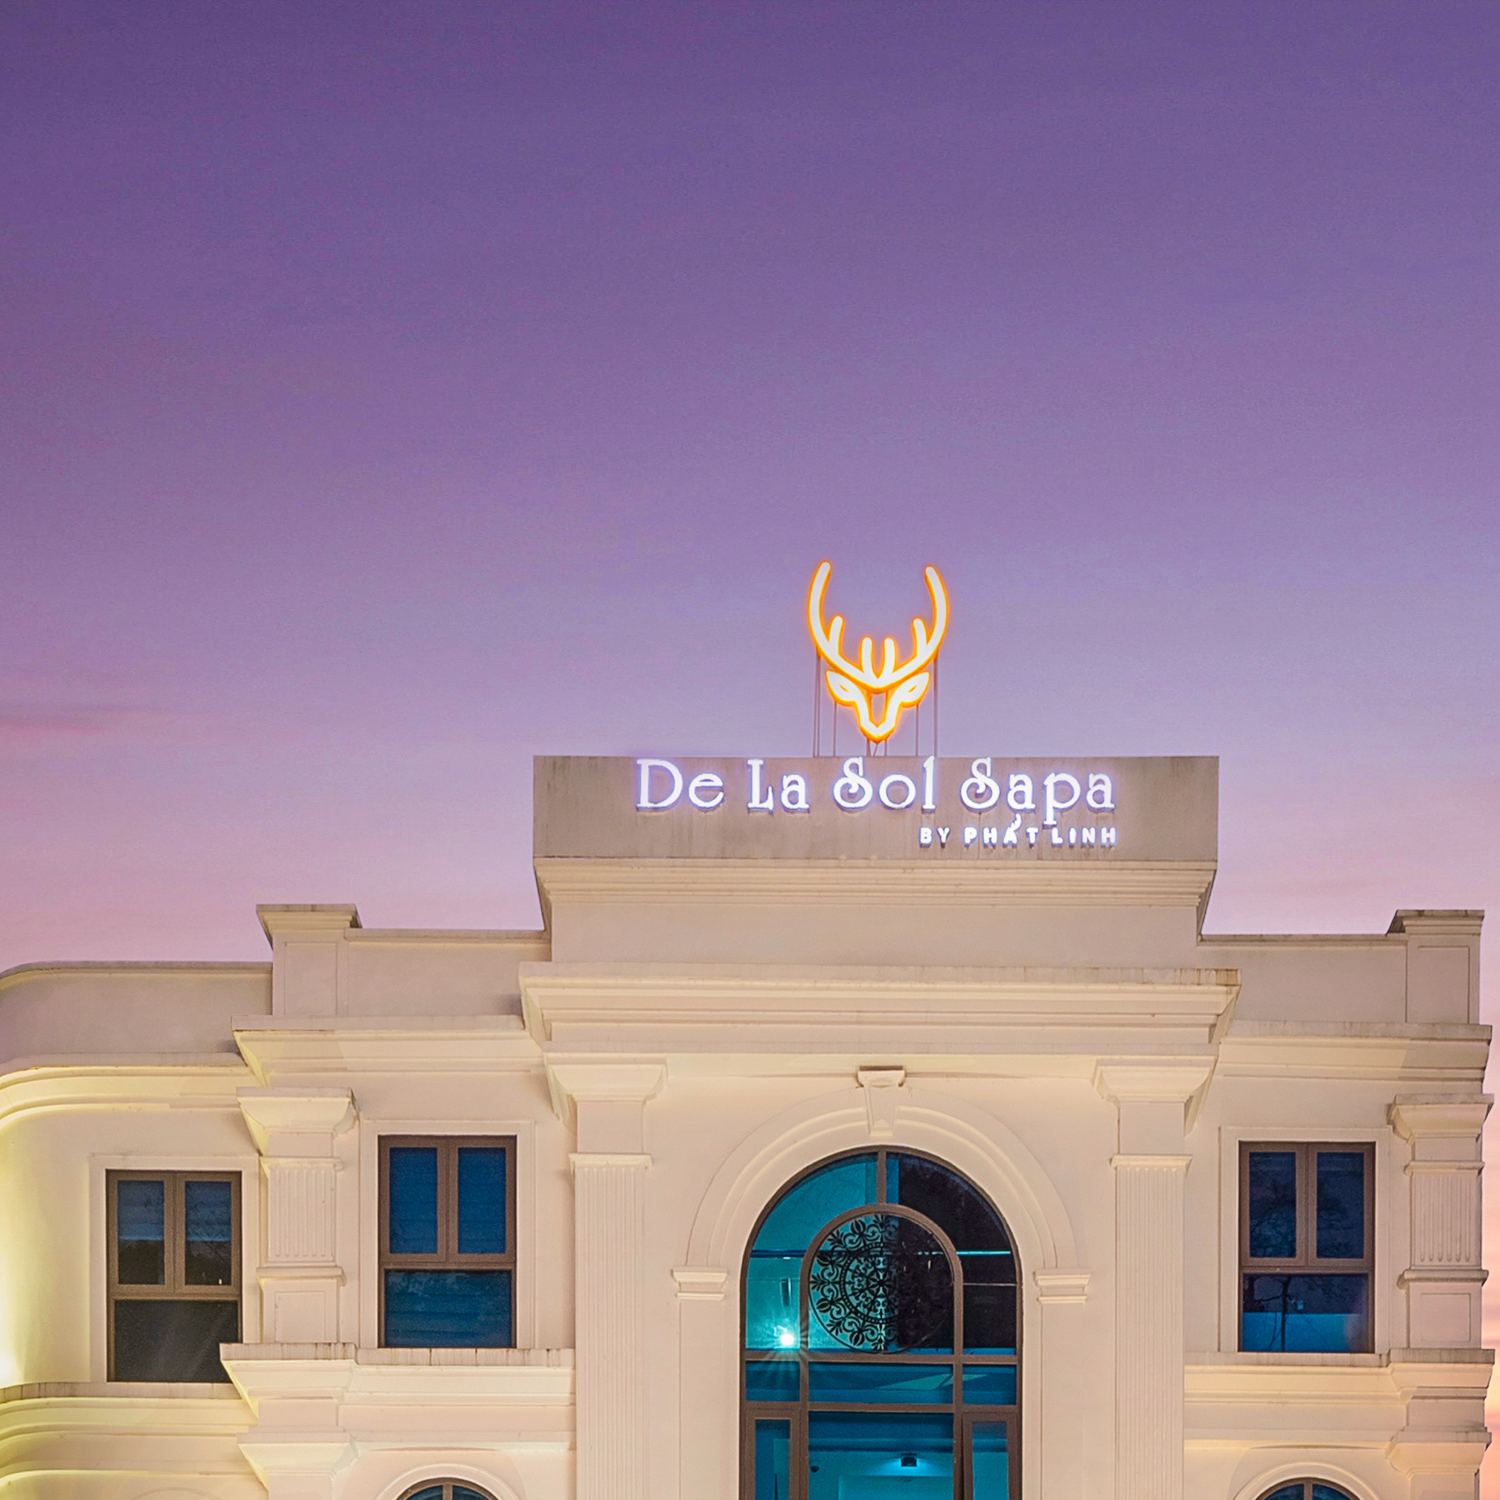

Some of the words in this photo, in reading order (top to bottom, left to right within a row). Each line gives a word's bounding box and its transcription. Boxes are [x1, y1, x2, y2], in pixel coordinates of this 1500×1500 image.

[636, 758, 725, 810] De
[746, 759, 810, 811] La
[833, 755, 936, 811] Sol
[960, 757, 1116, 827] Sapa
[919, 826, 950, 848] BY
[1050, 826, 1117, 848] LINH
